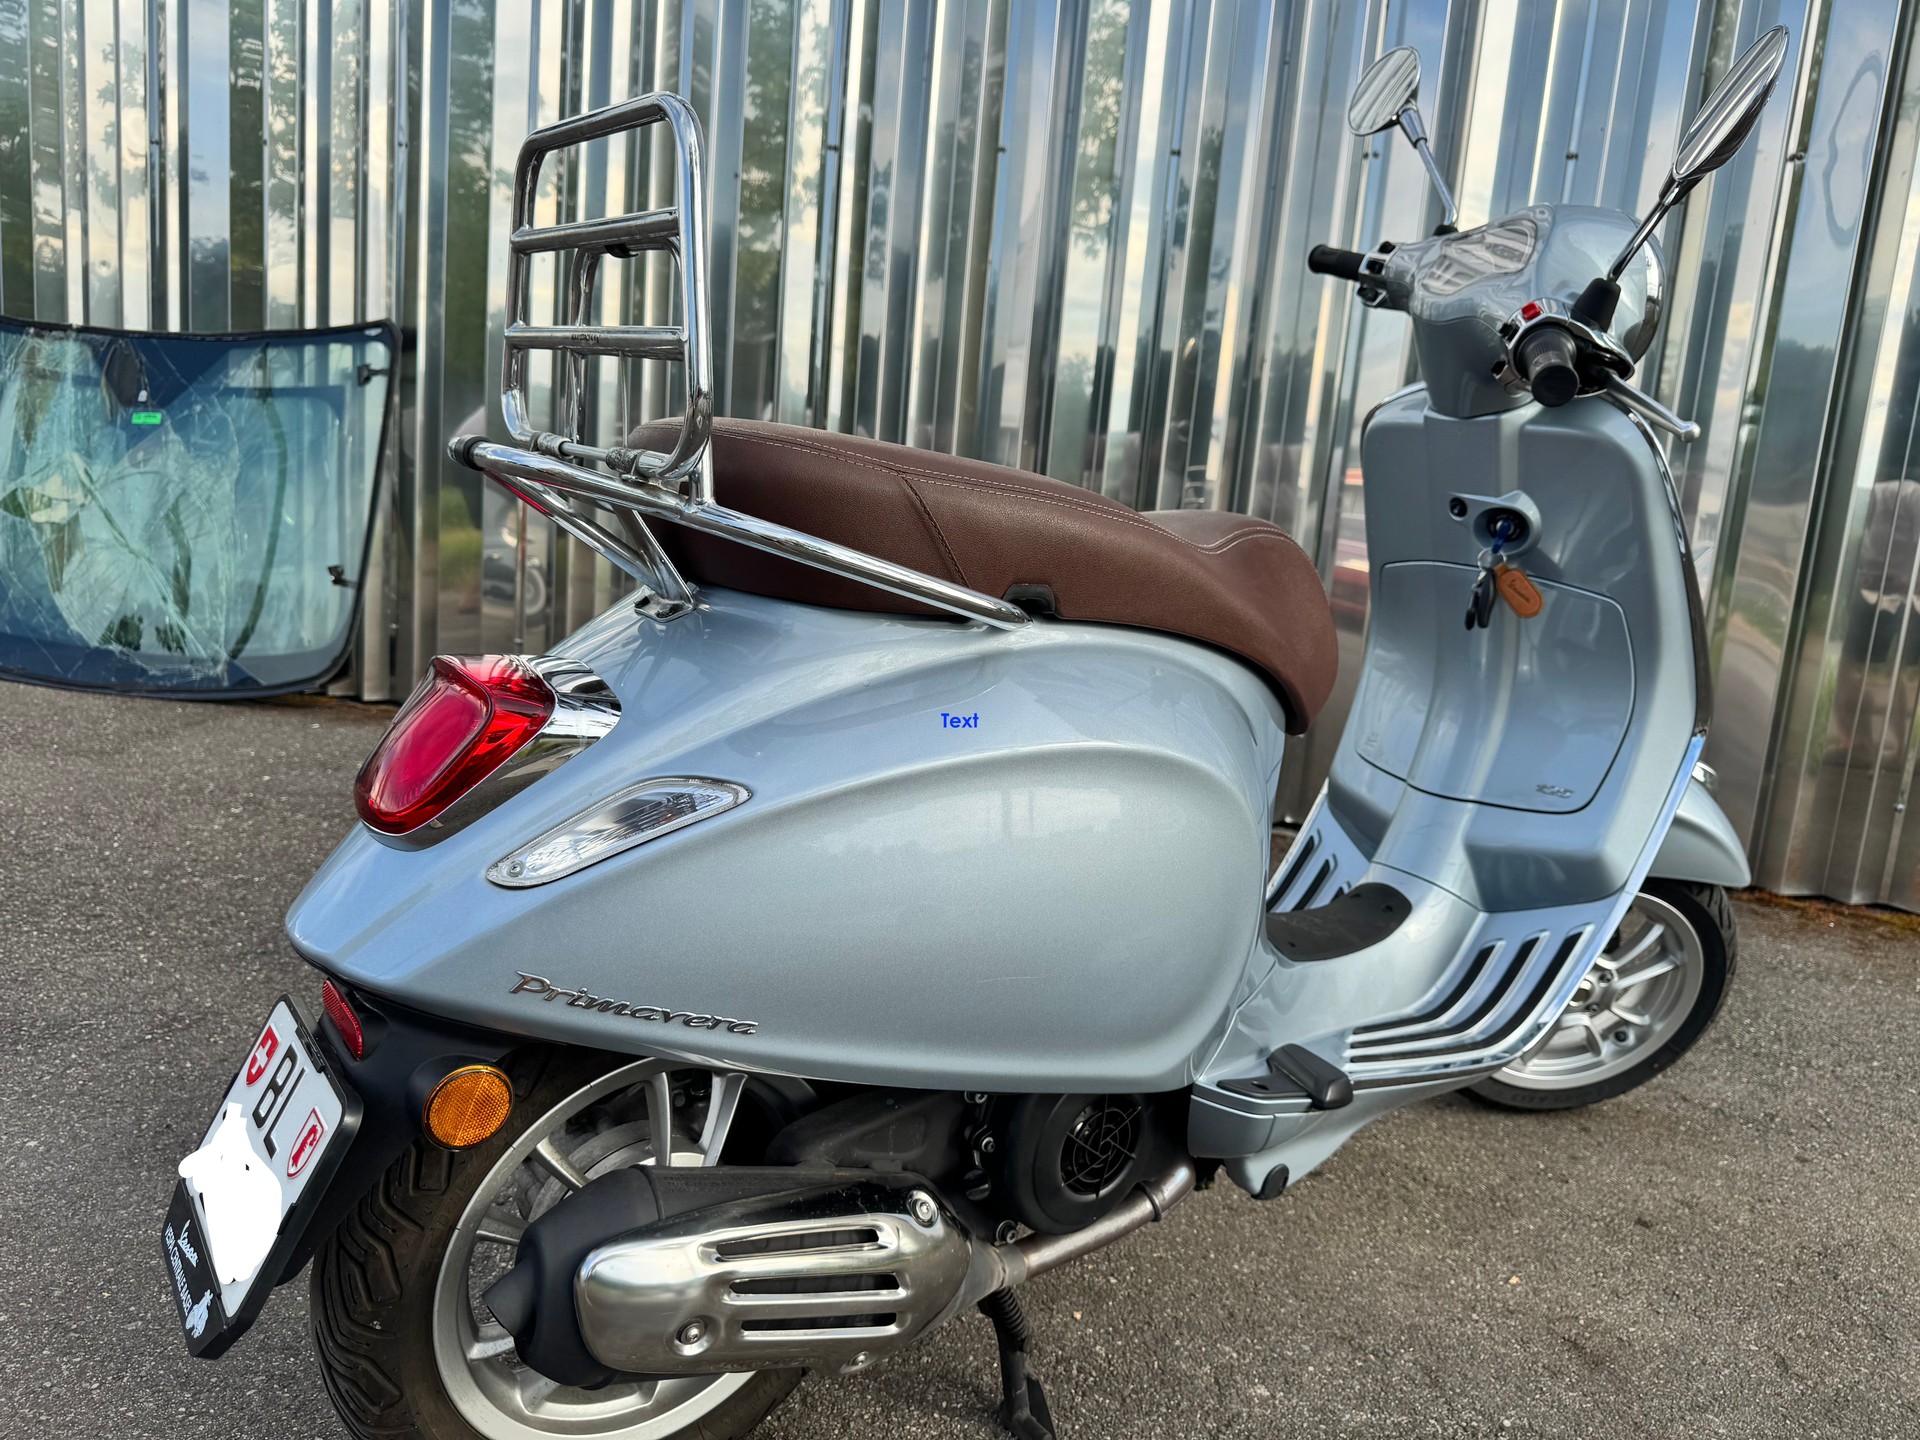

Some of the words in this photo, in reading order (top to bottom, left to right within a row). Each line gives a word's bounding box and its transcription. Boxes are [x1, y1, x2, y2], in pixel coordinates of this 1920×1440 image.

[509, 970, 759, 1035] Primavera
[252, 1043, 306, 1160] BL
[164, 1222, 176, 1254] VESPA
[170, 1246, 187, 1292] CENTRALE
[179, 1283, 193, 1317] BASEL
[177, 1219, 199, 1268] Vespa
